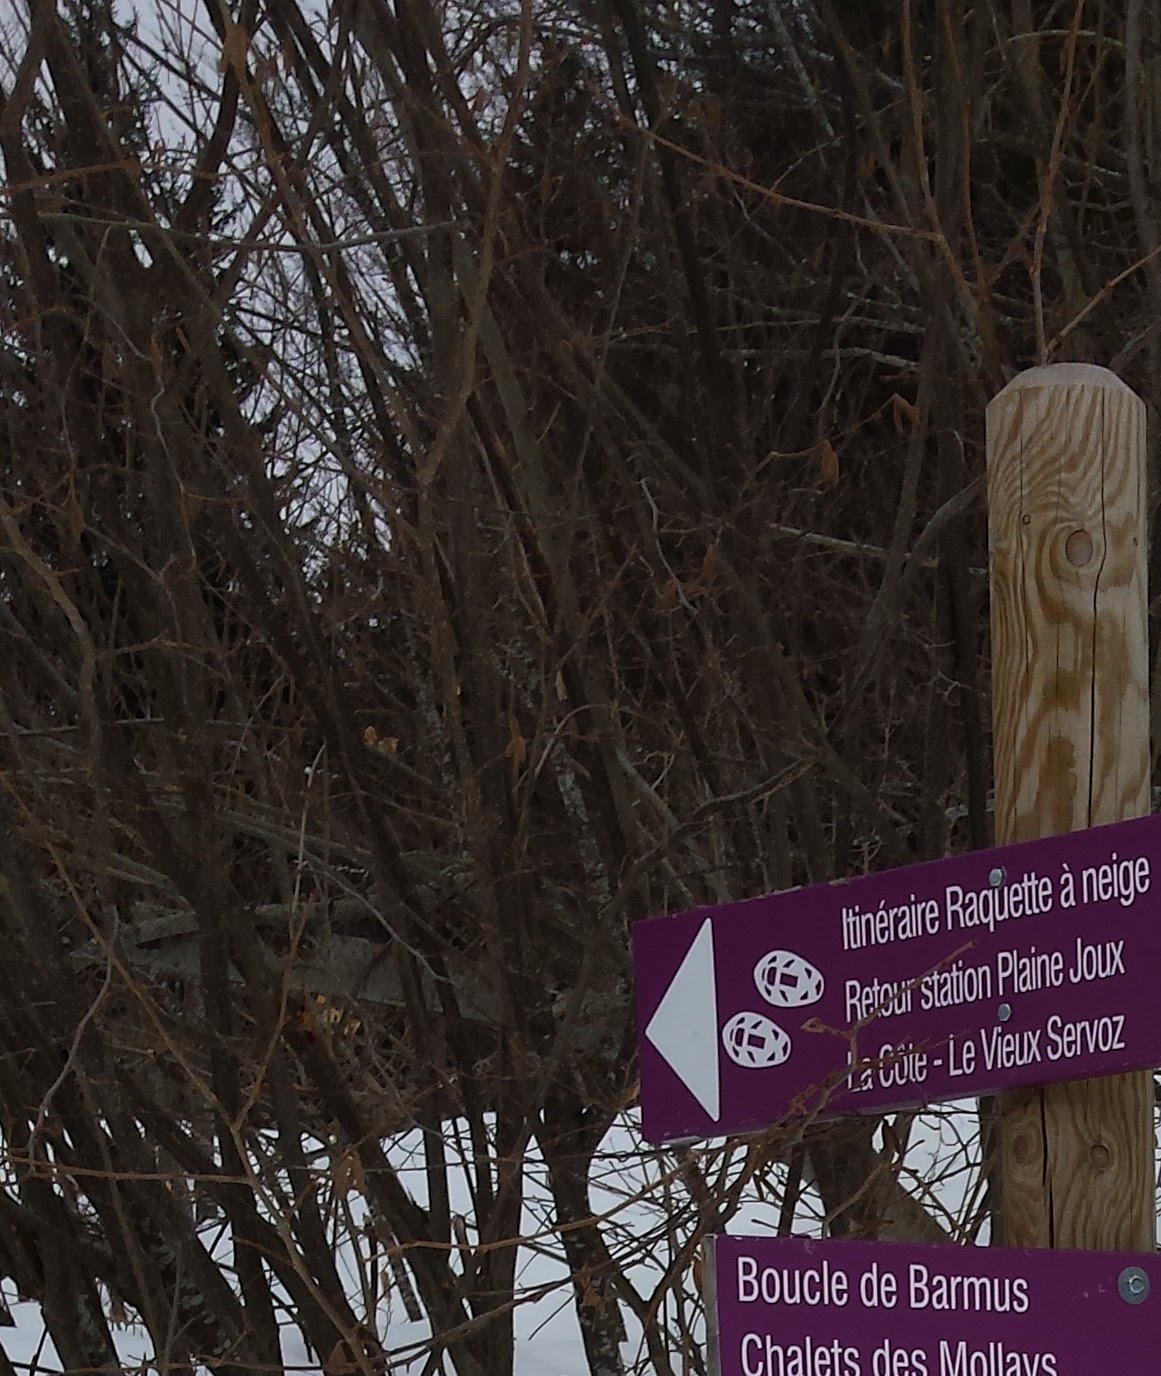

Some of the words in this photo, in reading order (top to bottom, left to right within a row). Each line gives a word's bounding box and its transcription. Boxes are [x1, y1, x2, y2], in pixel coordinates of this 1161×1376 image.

[842, 894, 940, 950] Itinéraire
[945, 872, 1052, 933] Raquette
[1060, 863, 1076, 908] à
[1082, 852, 1150, 906] neige
[845, 977, 915, 1023] Retour
[921, 960, 992, 1010] station
[997, 946, 1064, 996] Plaine
[1069, 938, 1126, 984] Joux
[948, 1034, 976, 1077] Le
[980, 1026, 1042, 1071] Vieux
[1047, 1015, 1126, 1061] Servoz
[737, 1256, 848, 1306] Boucle
[860, 1262, 898, 1308] de
[909, 1264, 1030, 1313] Barmus
